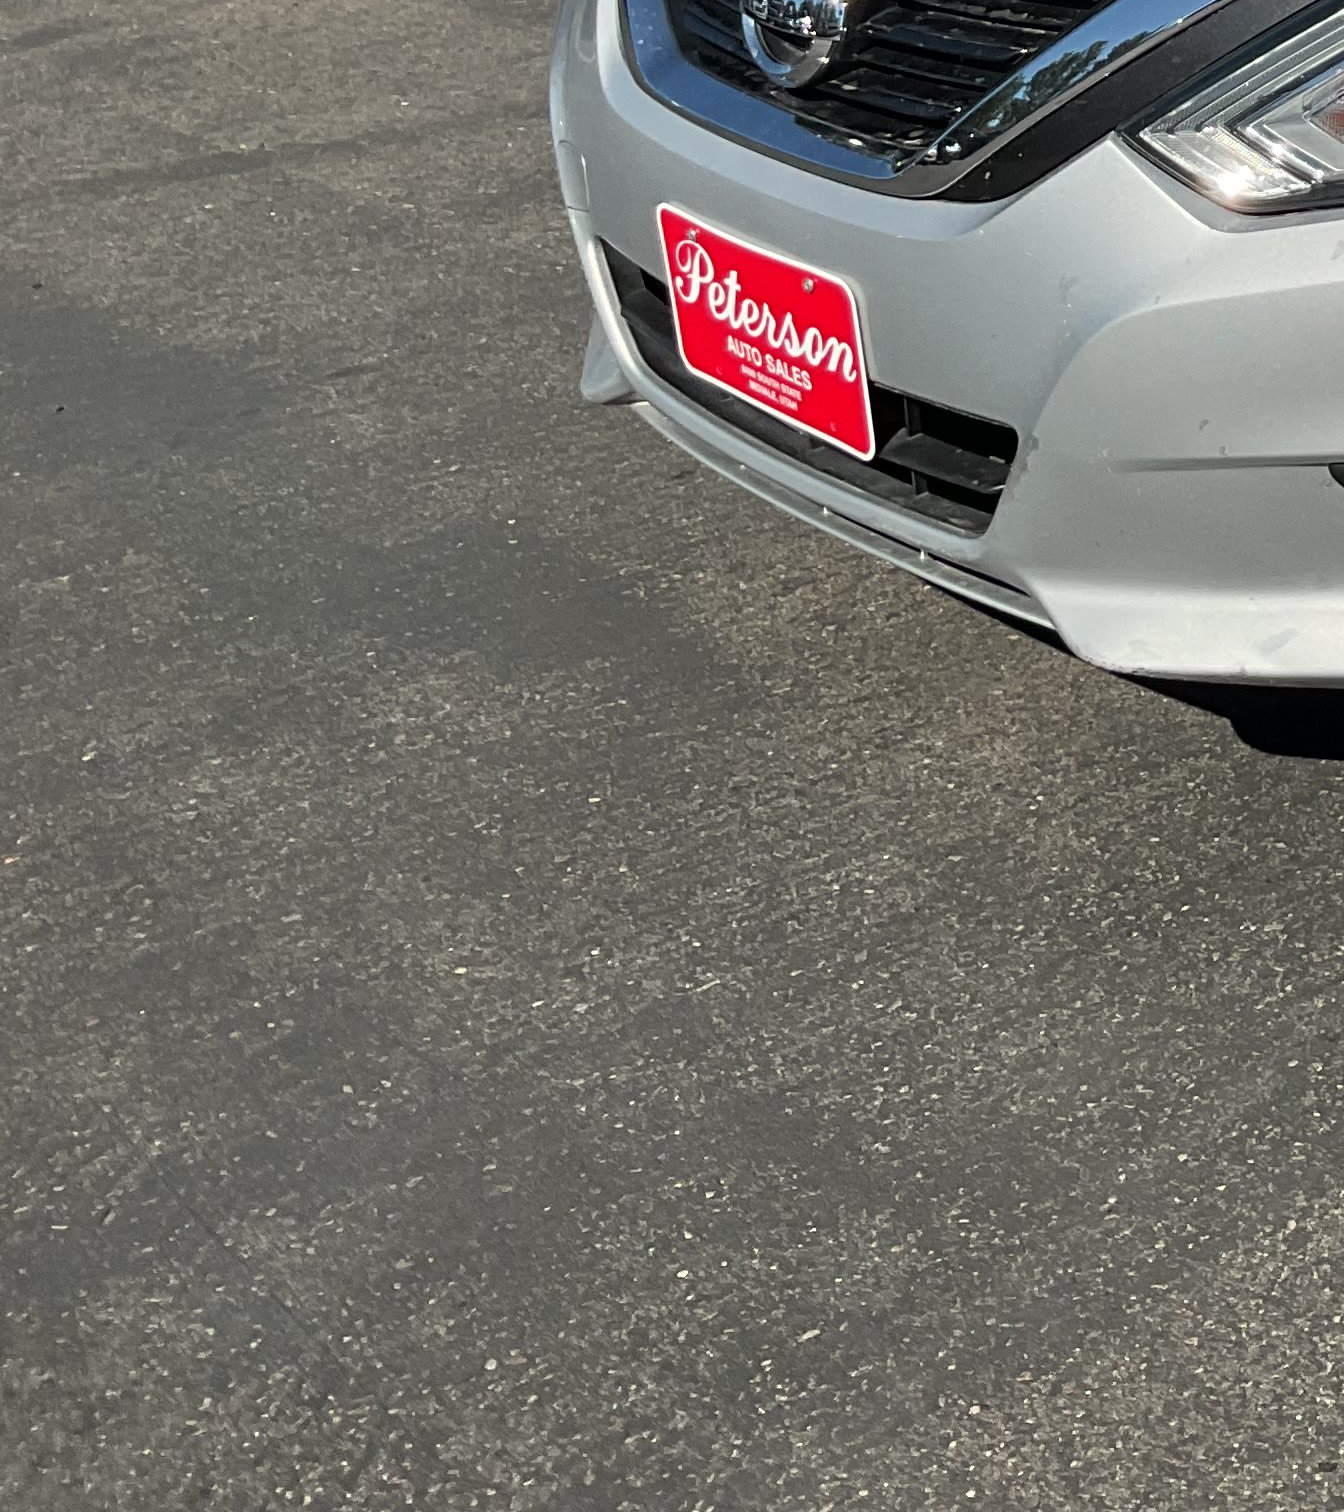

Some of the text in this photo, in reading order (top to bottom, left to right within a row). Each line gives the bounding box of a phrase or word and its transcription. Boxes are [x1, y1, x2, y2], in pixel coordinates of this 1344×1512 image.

[675, 240, 857, 383] Peterson
[727, 335, 813, 391] AUTO SALES
